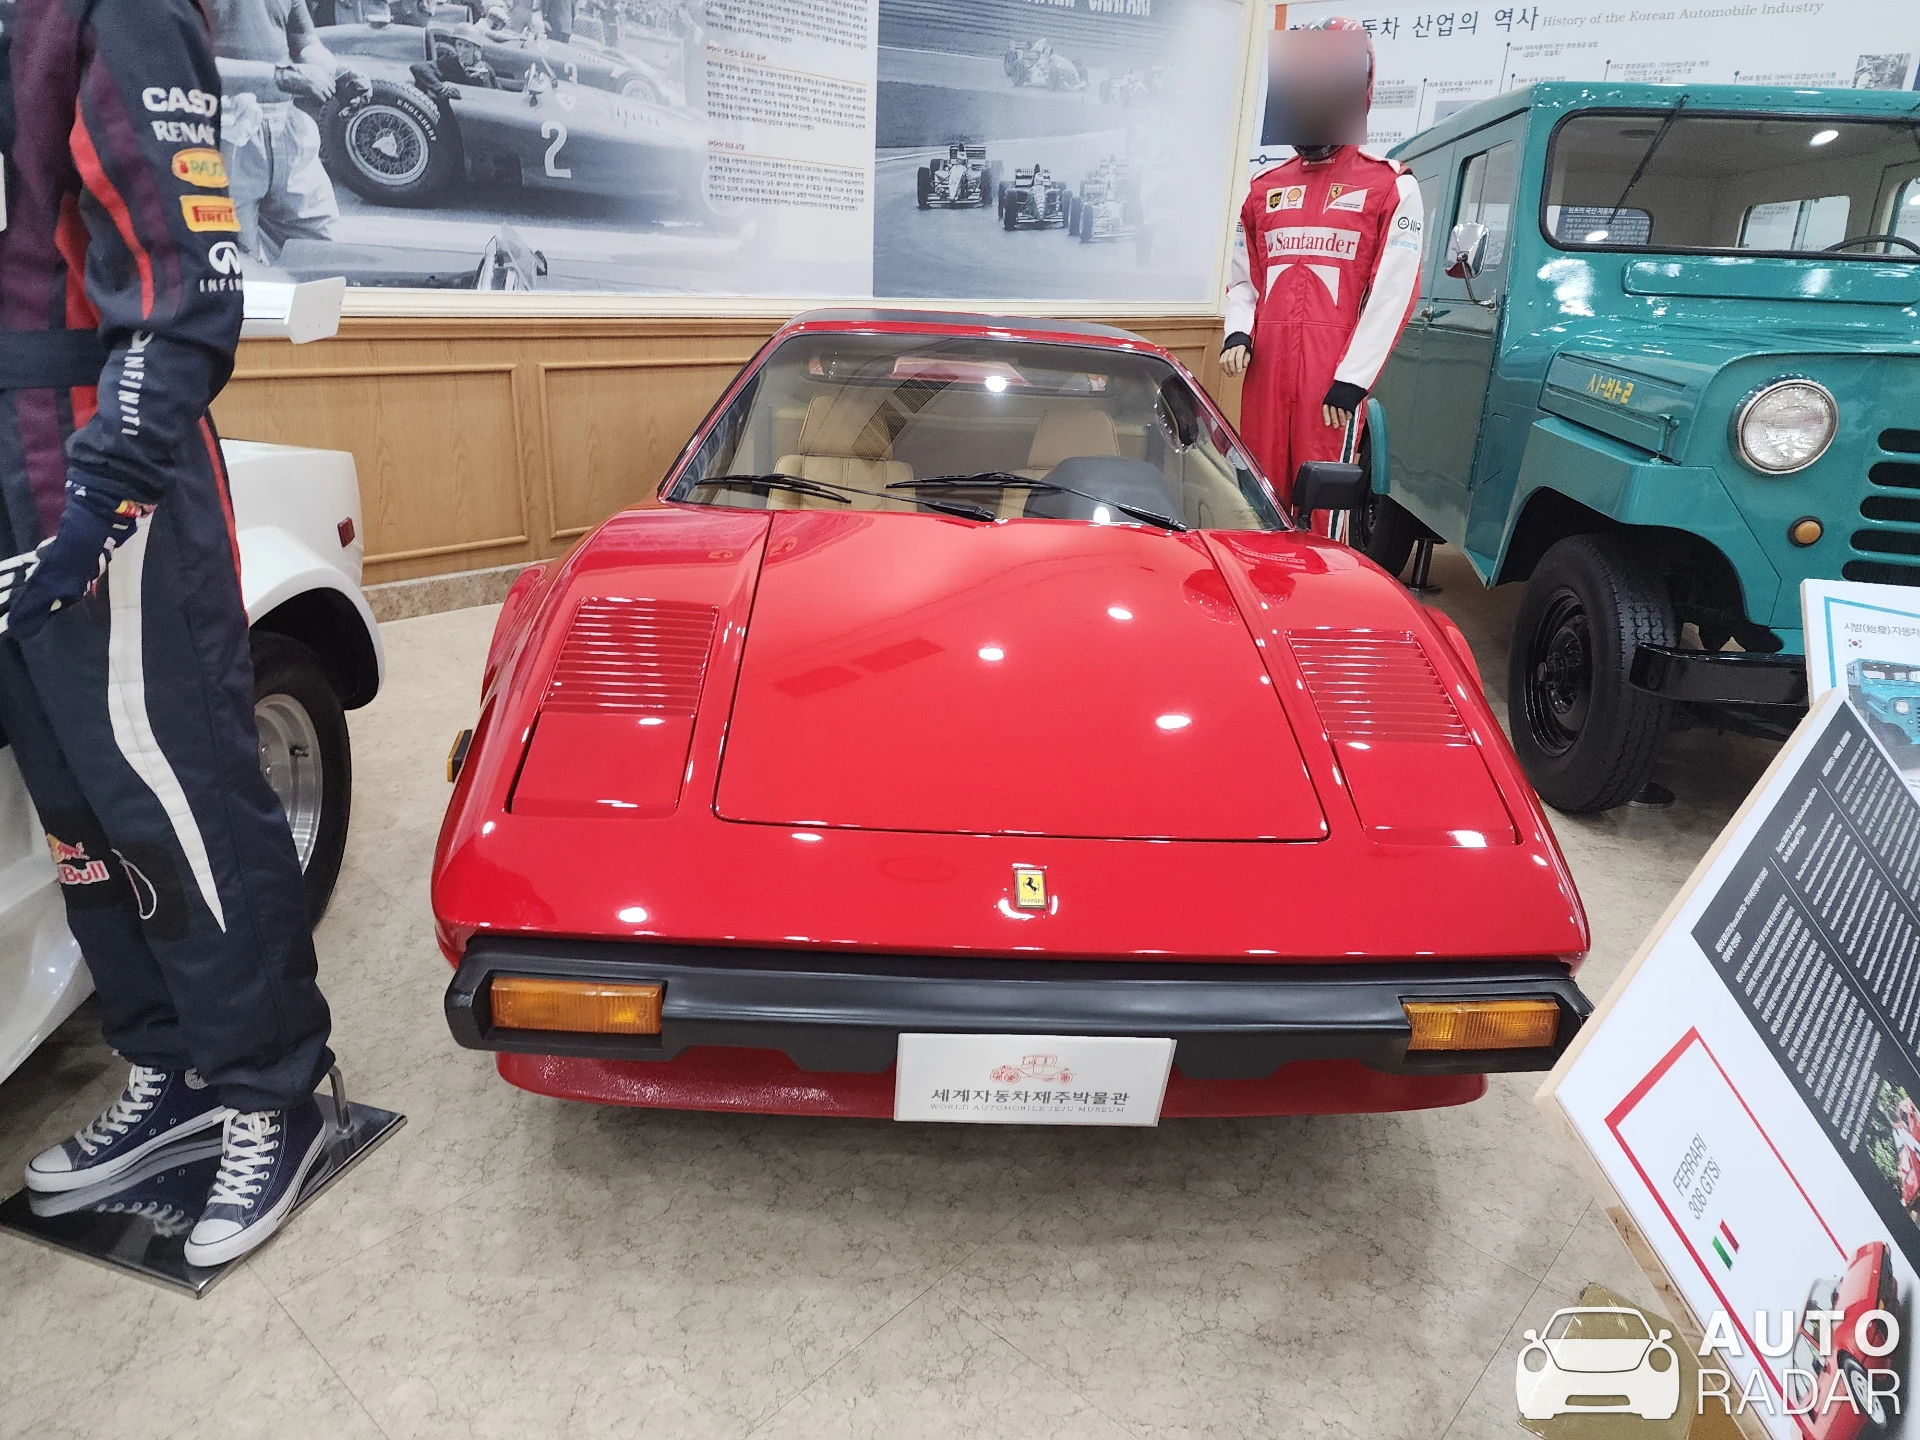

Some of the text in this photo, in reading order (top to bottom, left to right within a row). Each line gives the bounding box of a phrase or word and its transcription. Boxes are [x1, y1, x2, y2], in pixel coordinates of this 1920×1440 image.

[1411, 11, 1479, 39] 산업의
[1493, 6, 1540, 33] 역사
[1542, 1, 1825, 28] History of the Korean Automobile Industry
[540, 119, 572, 179] 2
[1274, 231, 1356, 255] Santander
[117, 346, 146, 436] INFINITI
[63, 861, 107, 883] Bull
[929, 1102, 1125, 1114] WORLD AUTOMOBILE JEJU MUSEUM
[930, 1088, 1130, 1106] 세계자동차제주박물관
[1672, 1133, 1708, 1198] FERRARI
[1688, 1187, 1707, 1220] 308
